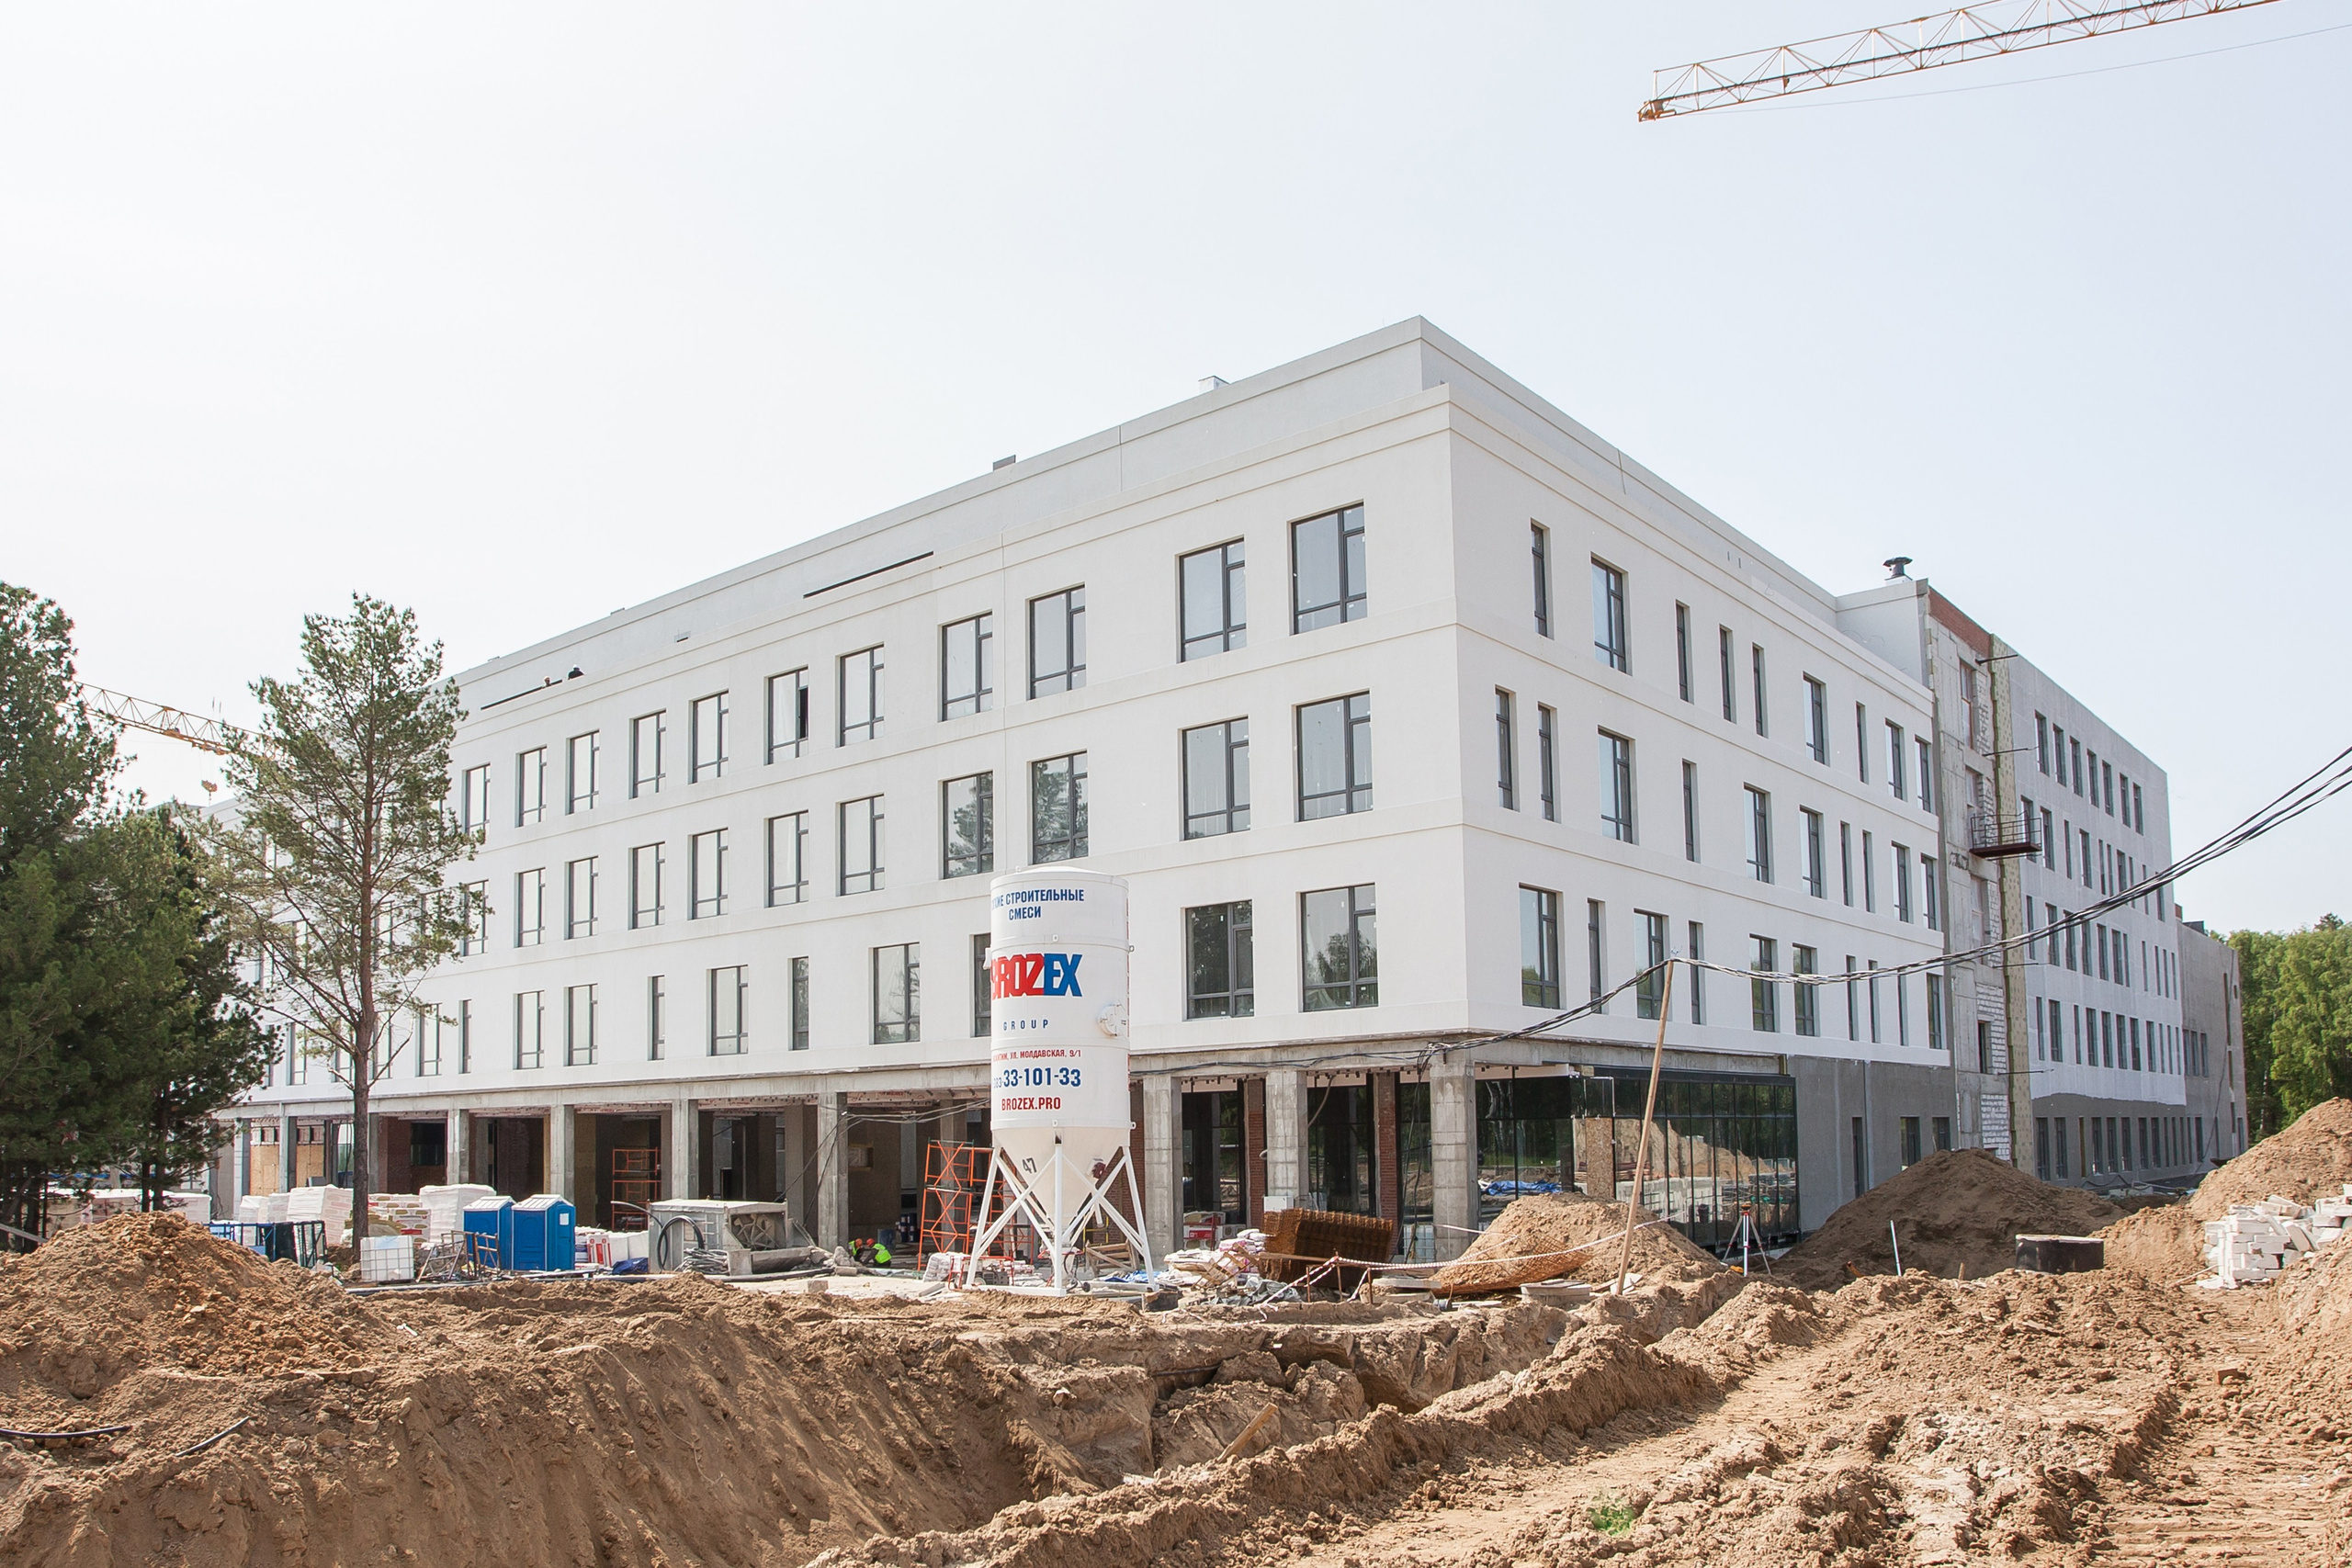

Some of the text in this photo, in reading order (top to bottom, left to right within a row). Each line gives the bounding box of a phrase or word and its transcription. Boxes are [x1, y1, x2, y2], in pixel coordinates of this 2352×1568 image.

[1005, 889, 1084, 906] СТРОИТЕЛЬНЫЕ
[1009, 906, 1042, 920] СМЕСИ
[1002, 1019, 1049, 1031] GROUP
[1020, 1049, 1067, 1059] МОЛДАВСКАЯ,
[1069, 1049, 1081, 1057] 9/1
[1001, 1097, 1061, 1111] BROZEX.PRO
[1022, 1157, 1037, 1174] 47
